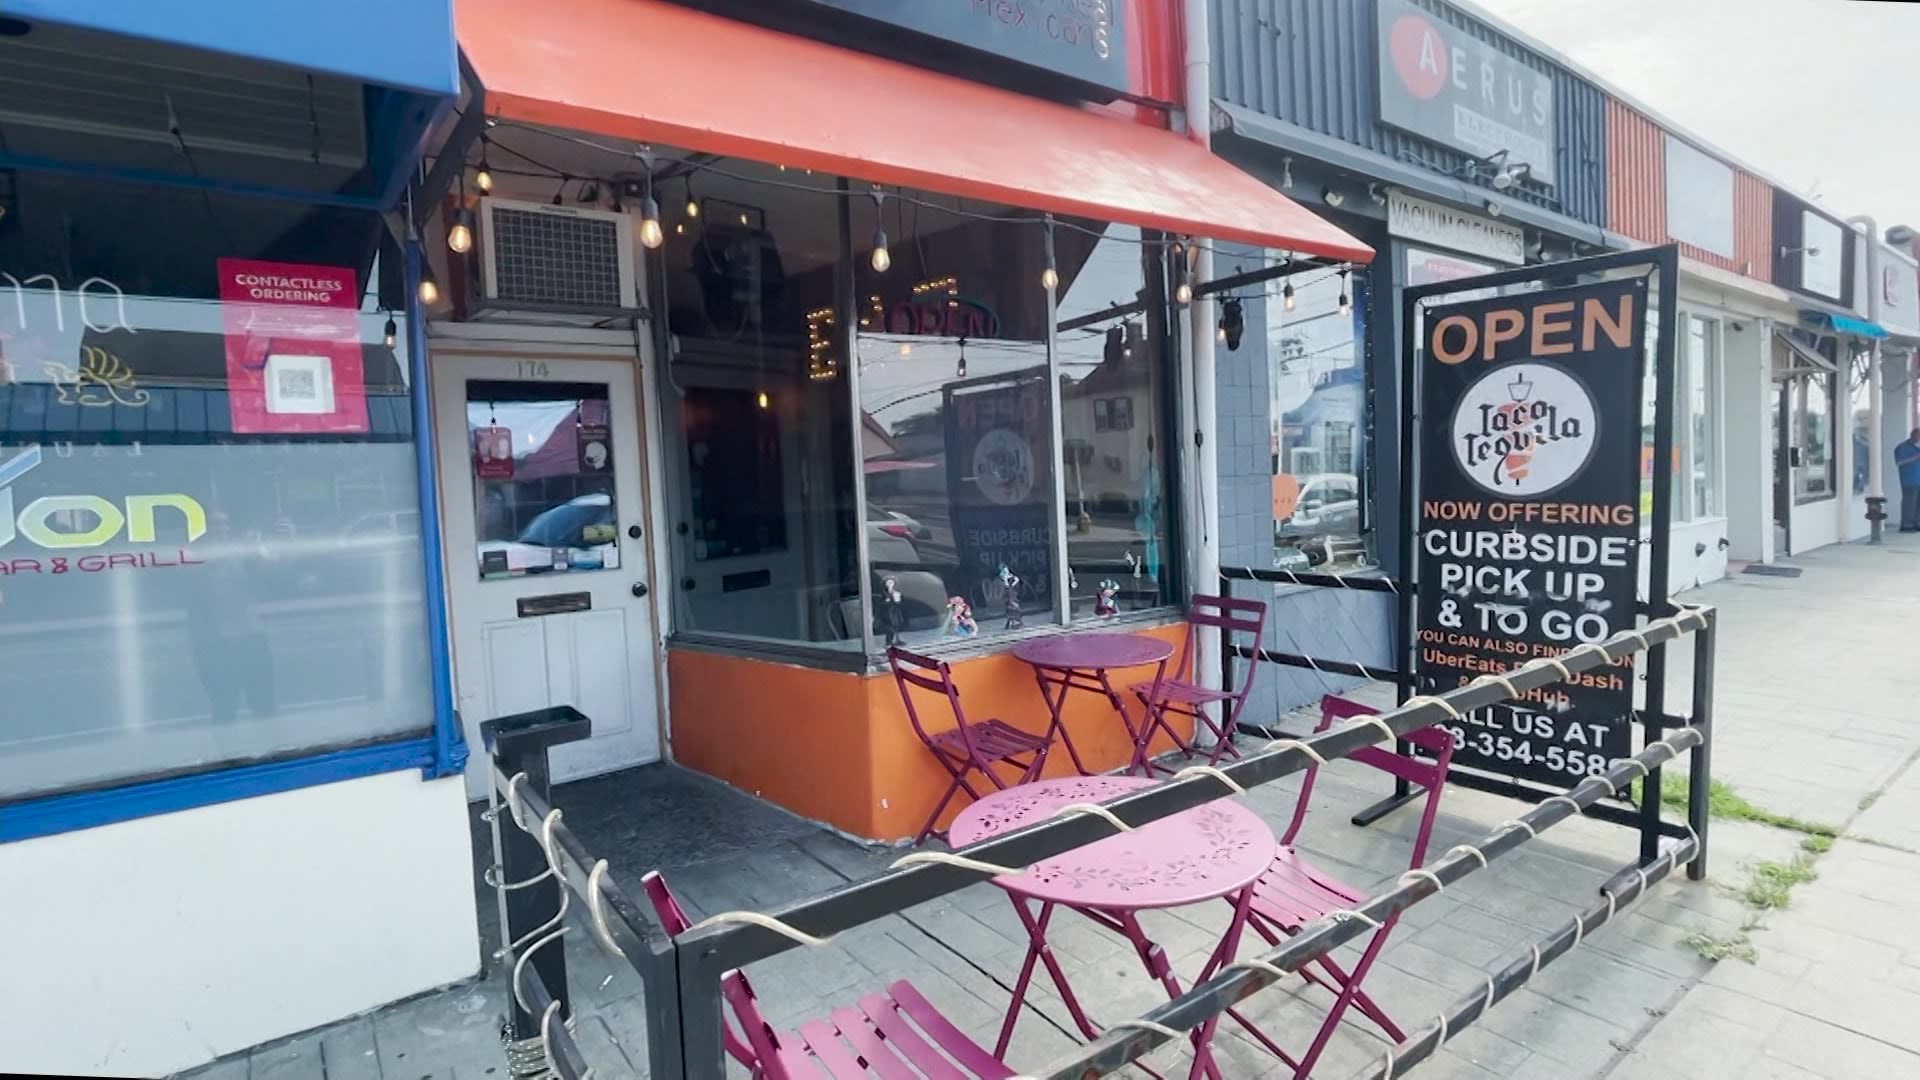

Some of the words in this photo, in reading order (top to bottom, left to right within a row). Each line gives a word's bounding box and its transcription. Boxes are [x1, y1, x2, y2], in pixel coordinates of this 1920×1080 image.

[1418, 31, 1546, 126] AERUS
[235, 274, 342, 291] CONTACTLESS
[250, 288, 331, 302] ORDERING
[1432, 294, 1633, 365] OPEN
[516, 359, 551, 377] 174
[1478, 399, 1548, 438] Taco
[1463, 405, 1583, 486] Tequila
[1423, 501, 1481, 521] NOW
[1488, 502, 1634, 525] OFFERING
[78, 549, 207, 573] GRILL
[1424, 529, 1628, 567] CURBSIDE
[1441, 563, 1532, 599] PICK
[1545, 571, 1606, 602] UP
[1437, 599, 1463, 629] &
[1474, 603, 1528, 635] TO
[1541, 610, 1609, 644] GO
[1416, 628, 1444, 643] YOU
[1447, 632, 1480, 648] CAN
[1483, 638, 1528, 655] ALSO
[1423, 648, 1506, 673] UberEats
[1512, 709, 1555, 739] US
[1563, 721, 1610, 747] AT
[1433, 723, 1620, 777] 8-354-558
